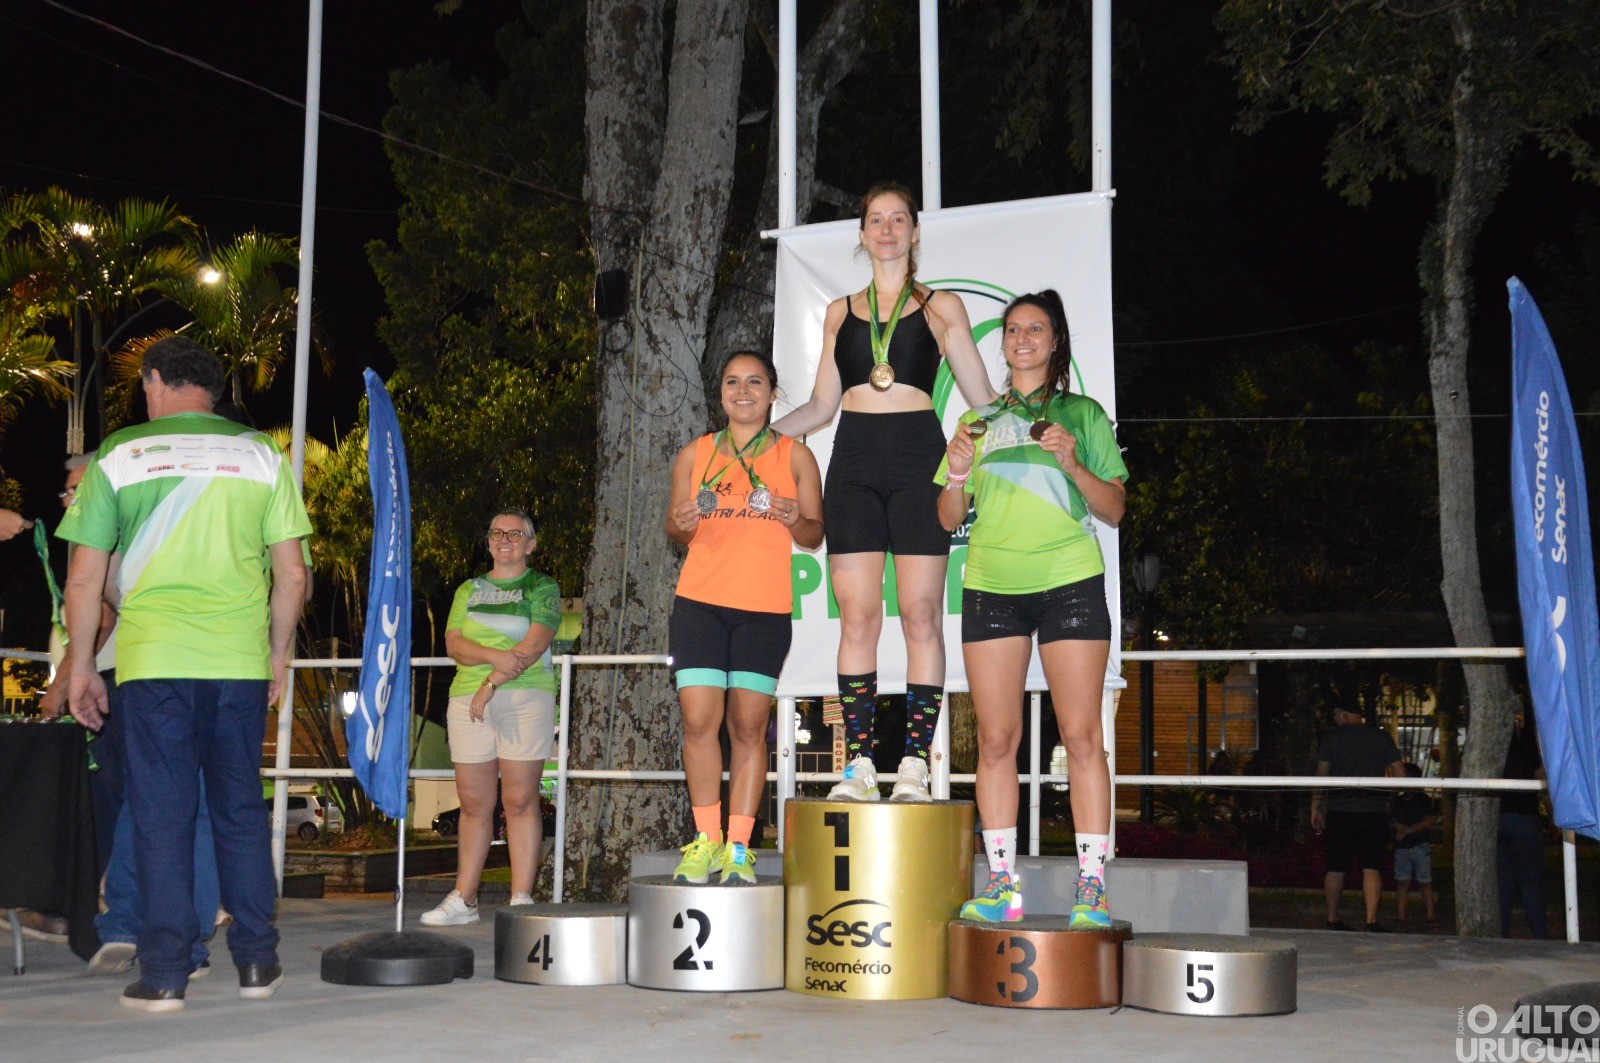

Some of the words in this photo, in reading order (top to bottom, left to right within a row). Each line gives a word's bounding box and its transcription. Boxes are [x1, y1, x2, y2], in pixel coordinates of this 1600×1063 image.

[1534, 390, 1549, 558] ecomércio
[1552, 474, 1567, 565] Senac
[361, 604, 401, 764] Sesc
[824, 812, 850, 891] 1
[527, 934, 553, 970] 4
[673, 908, 713, 970] 2
[806, 902, 892, 947] Sesc
[805, 957, 891, 975] Fecomércio
[805, 976, 847, 993] Senac
[996, 936, 1038, 1003] 3
[1186, 963, 1215, 1004] 5
